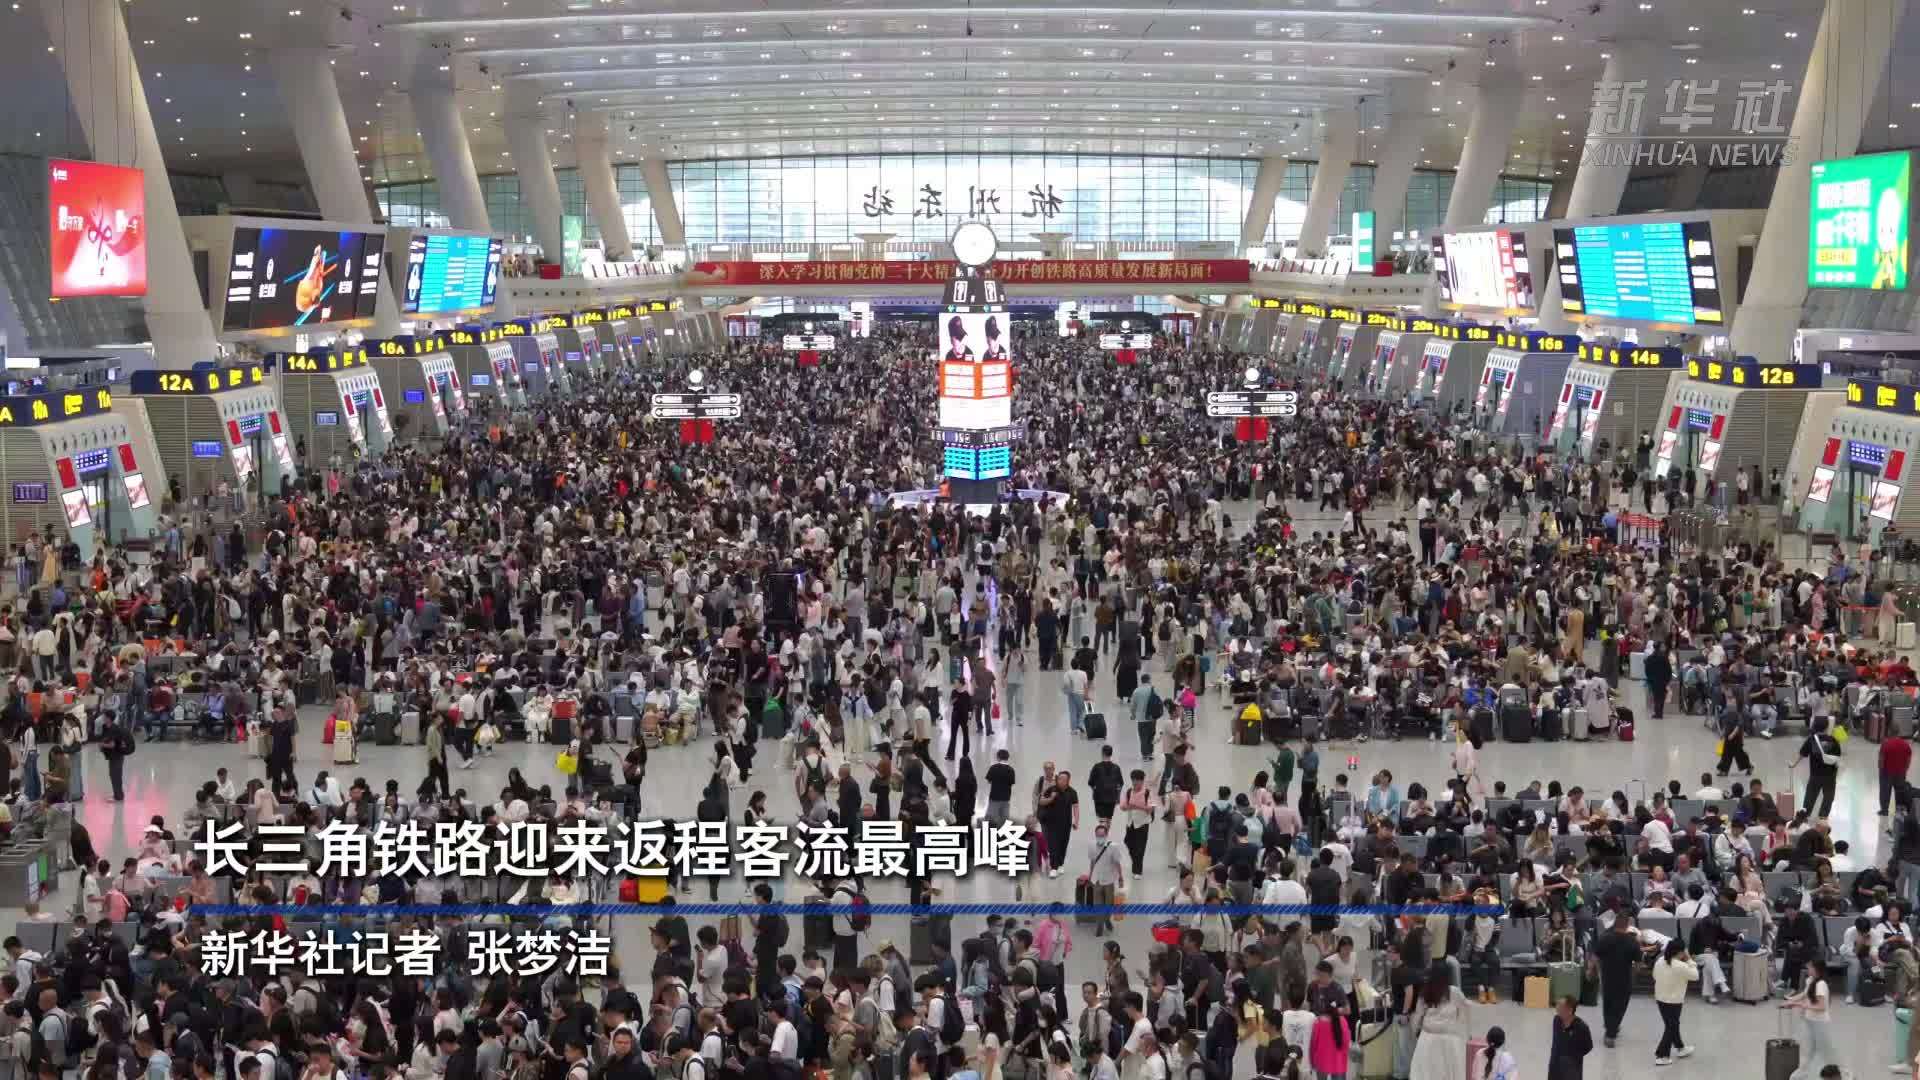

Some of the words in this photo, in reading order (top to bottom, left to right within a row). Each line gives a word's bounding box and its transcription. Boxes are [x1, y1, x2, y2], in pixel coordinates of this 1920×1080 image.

[759, 263, 957, 281] 深入学习贯彻党的二十大精
[504, 324, 524, 335] 20A
[1466, 328, 1489, 339] 18B
[451, 332, 473, 343] 18A
[1537, 338, 1563, 350] 16B
[380, 342, 405, 355] 16A
[288, 356, 317, 370] 14A
[1631, 350, 1660, 365] 14B
[1760, 367, 1794, 384] 12B
[159, 374, 194, 391] 12A
